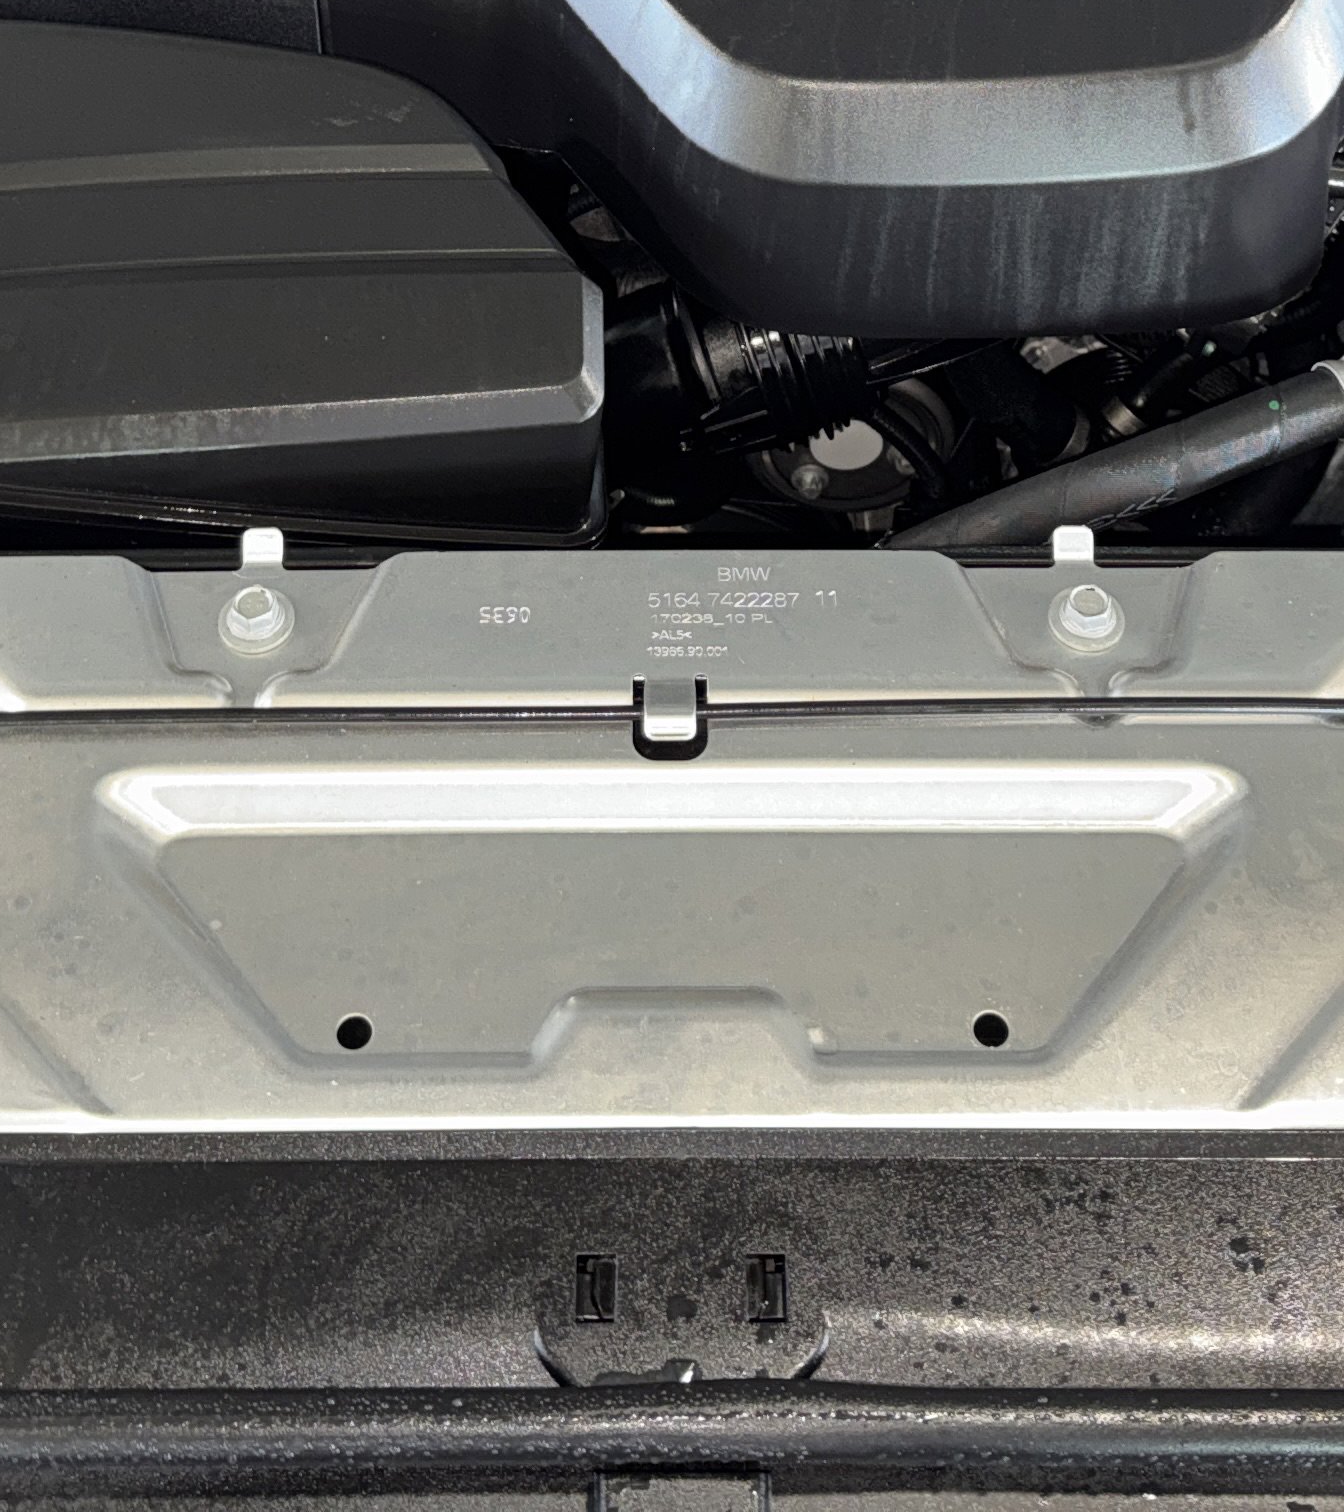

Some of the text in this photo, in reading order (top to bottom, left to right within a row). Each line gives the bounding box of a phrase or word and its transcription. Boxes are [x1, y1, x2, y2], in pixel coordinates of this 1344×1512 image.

[717, 566, 772, 582] BMW
[647, 590, 838, 608] 5164 7422287 11
[751, 613, 773, 624] PL
